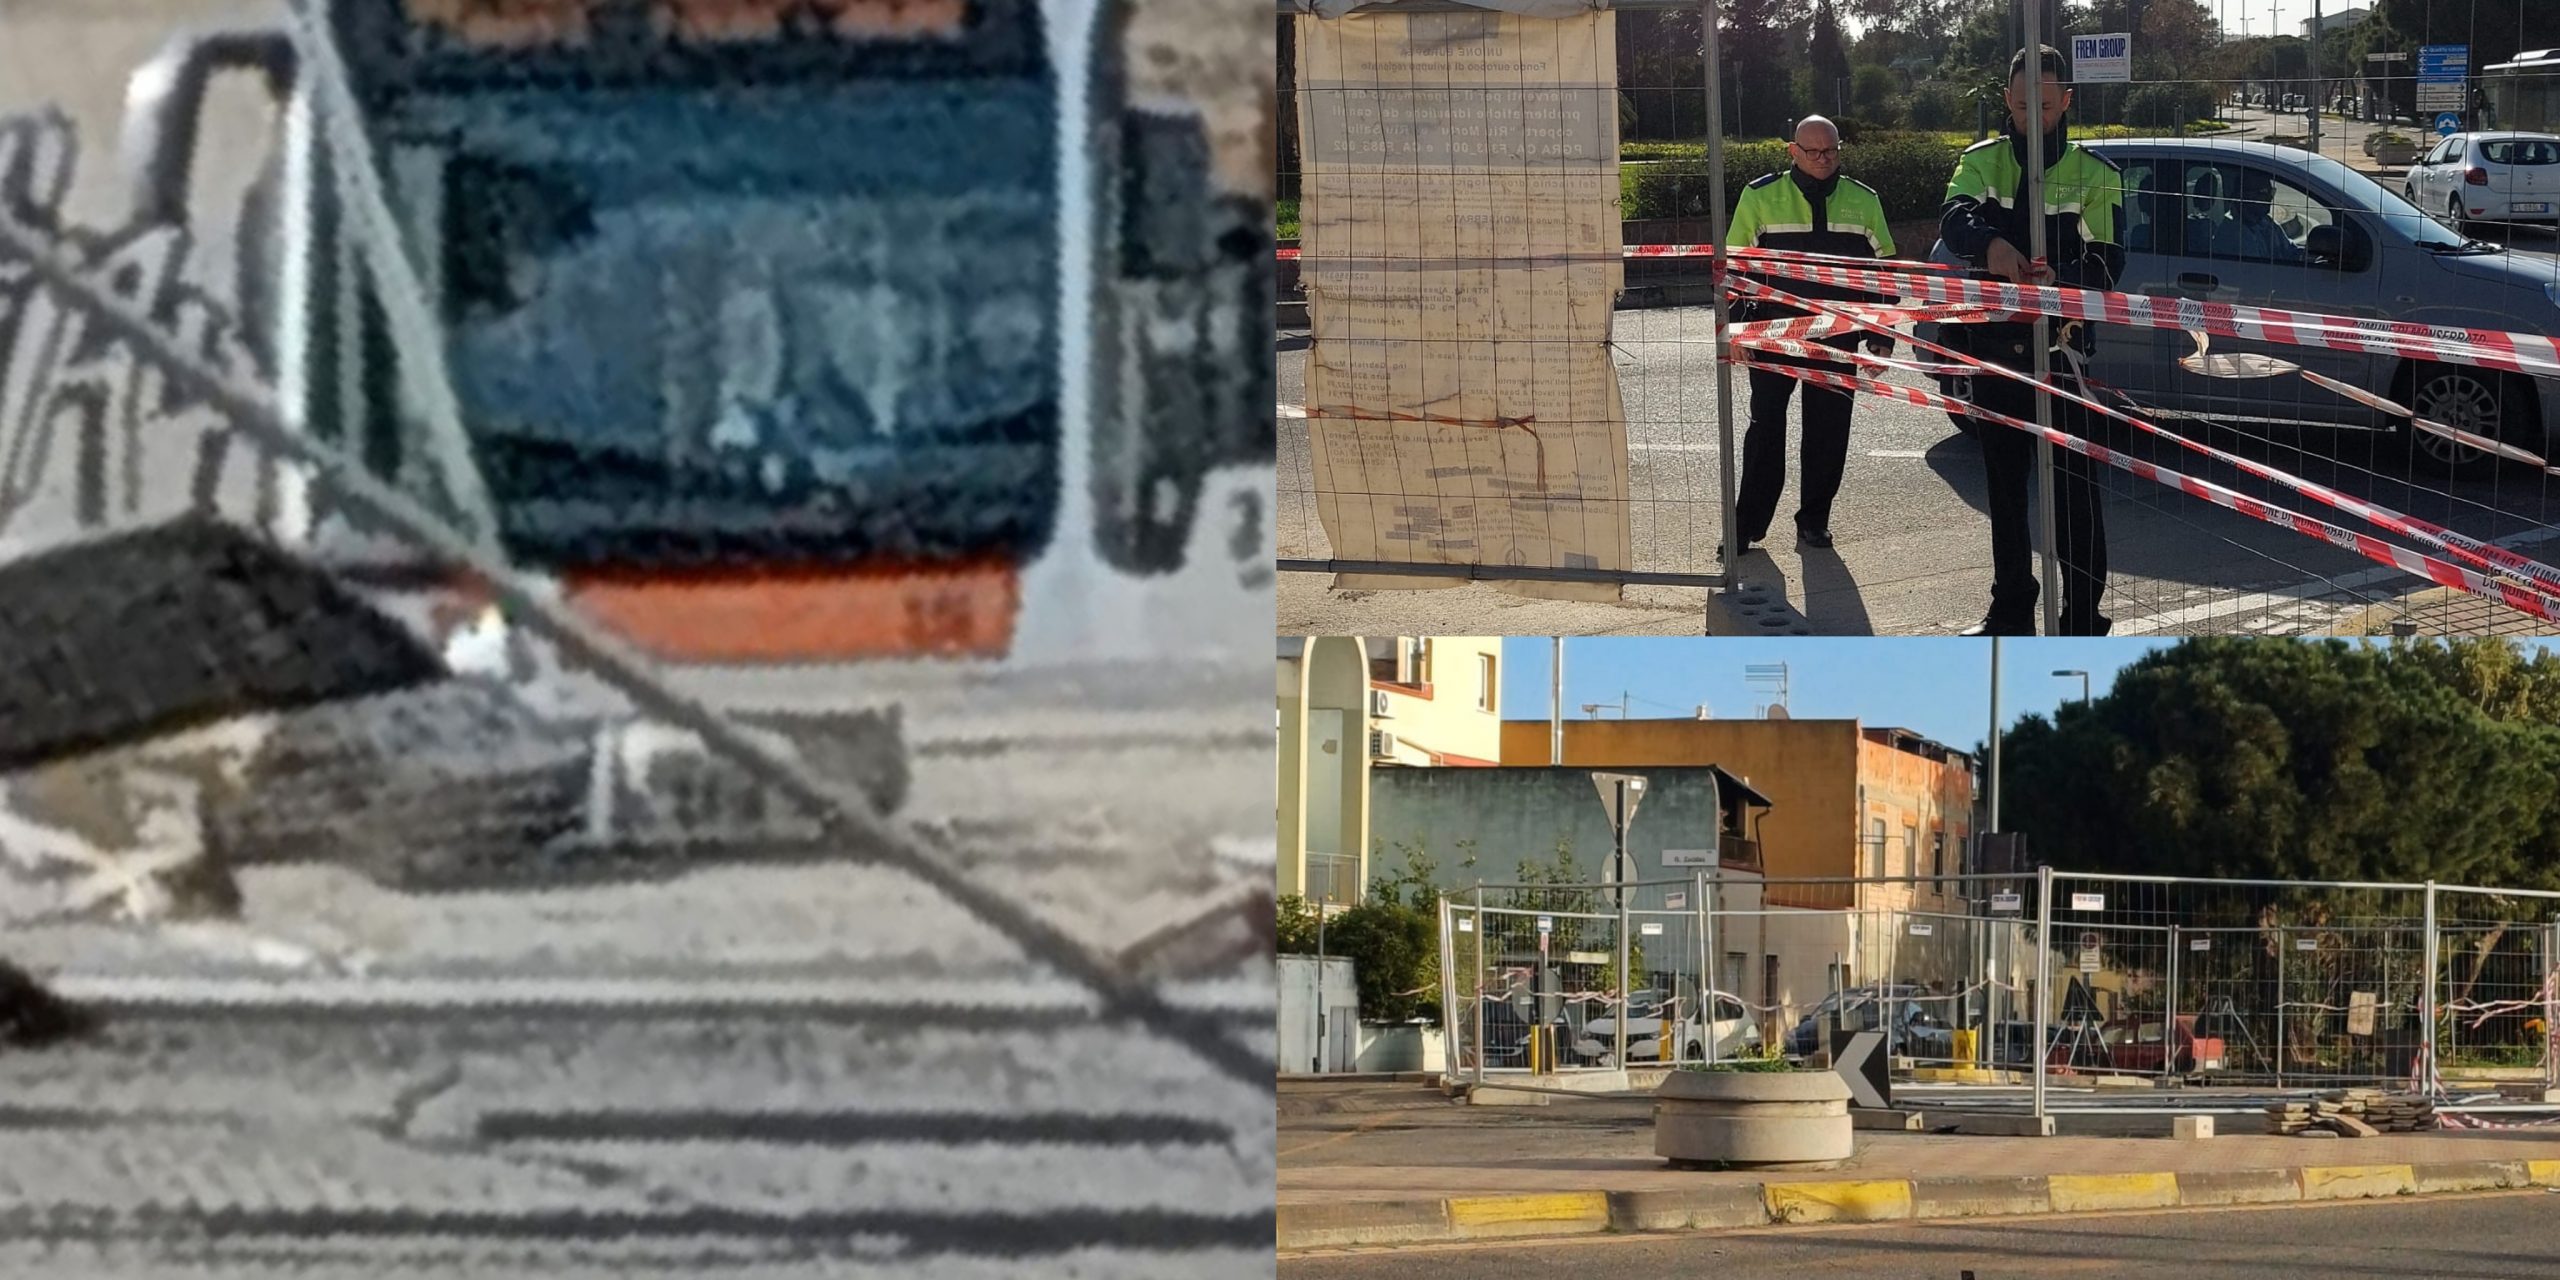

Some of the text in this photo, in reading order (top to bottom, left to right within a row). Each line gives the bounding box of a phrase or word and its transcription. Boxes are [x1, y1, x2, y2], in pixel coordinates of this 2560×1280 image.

[2076, 38, 2126, 59] FREM GROUP
[2139, 299, 2238, 319] COMUNE DI MONSERRATO
[2352, 321, 2394, 335] COMUNE
[2408, 326, 2489, 345] MONSERRATO
[2242, 499, 2281, 519] COMUNE
[2482, 576, 2531, 601] COMUNE
